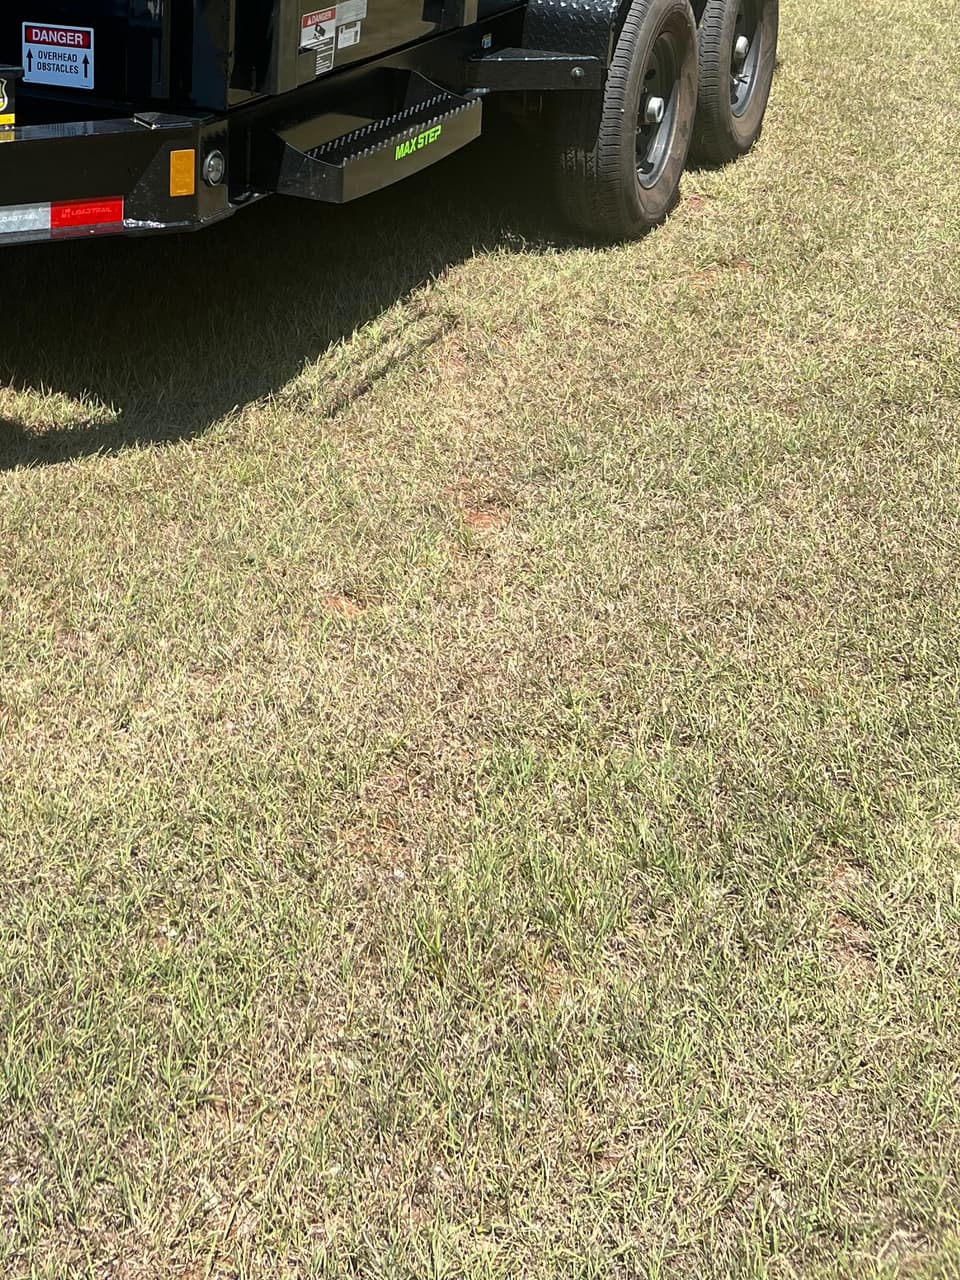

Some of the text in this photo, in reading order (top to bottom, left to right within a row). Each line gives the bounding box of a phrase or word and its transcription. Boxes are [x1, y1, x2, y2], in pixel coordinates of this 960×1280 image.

[32, 28, 84, 46] DANGER
[37, 50, 78, 63] OVERHEAD
[36, 61, 79, 75] OBSTACLES
[395, 124, 442, 161] MAX STEP
